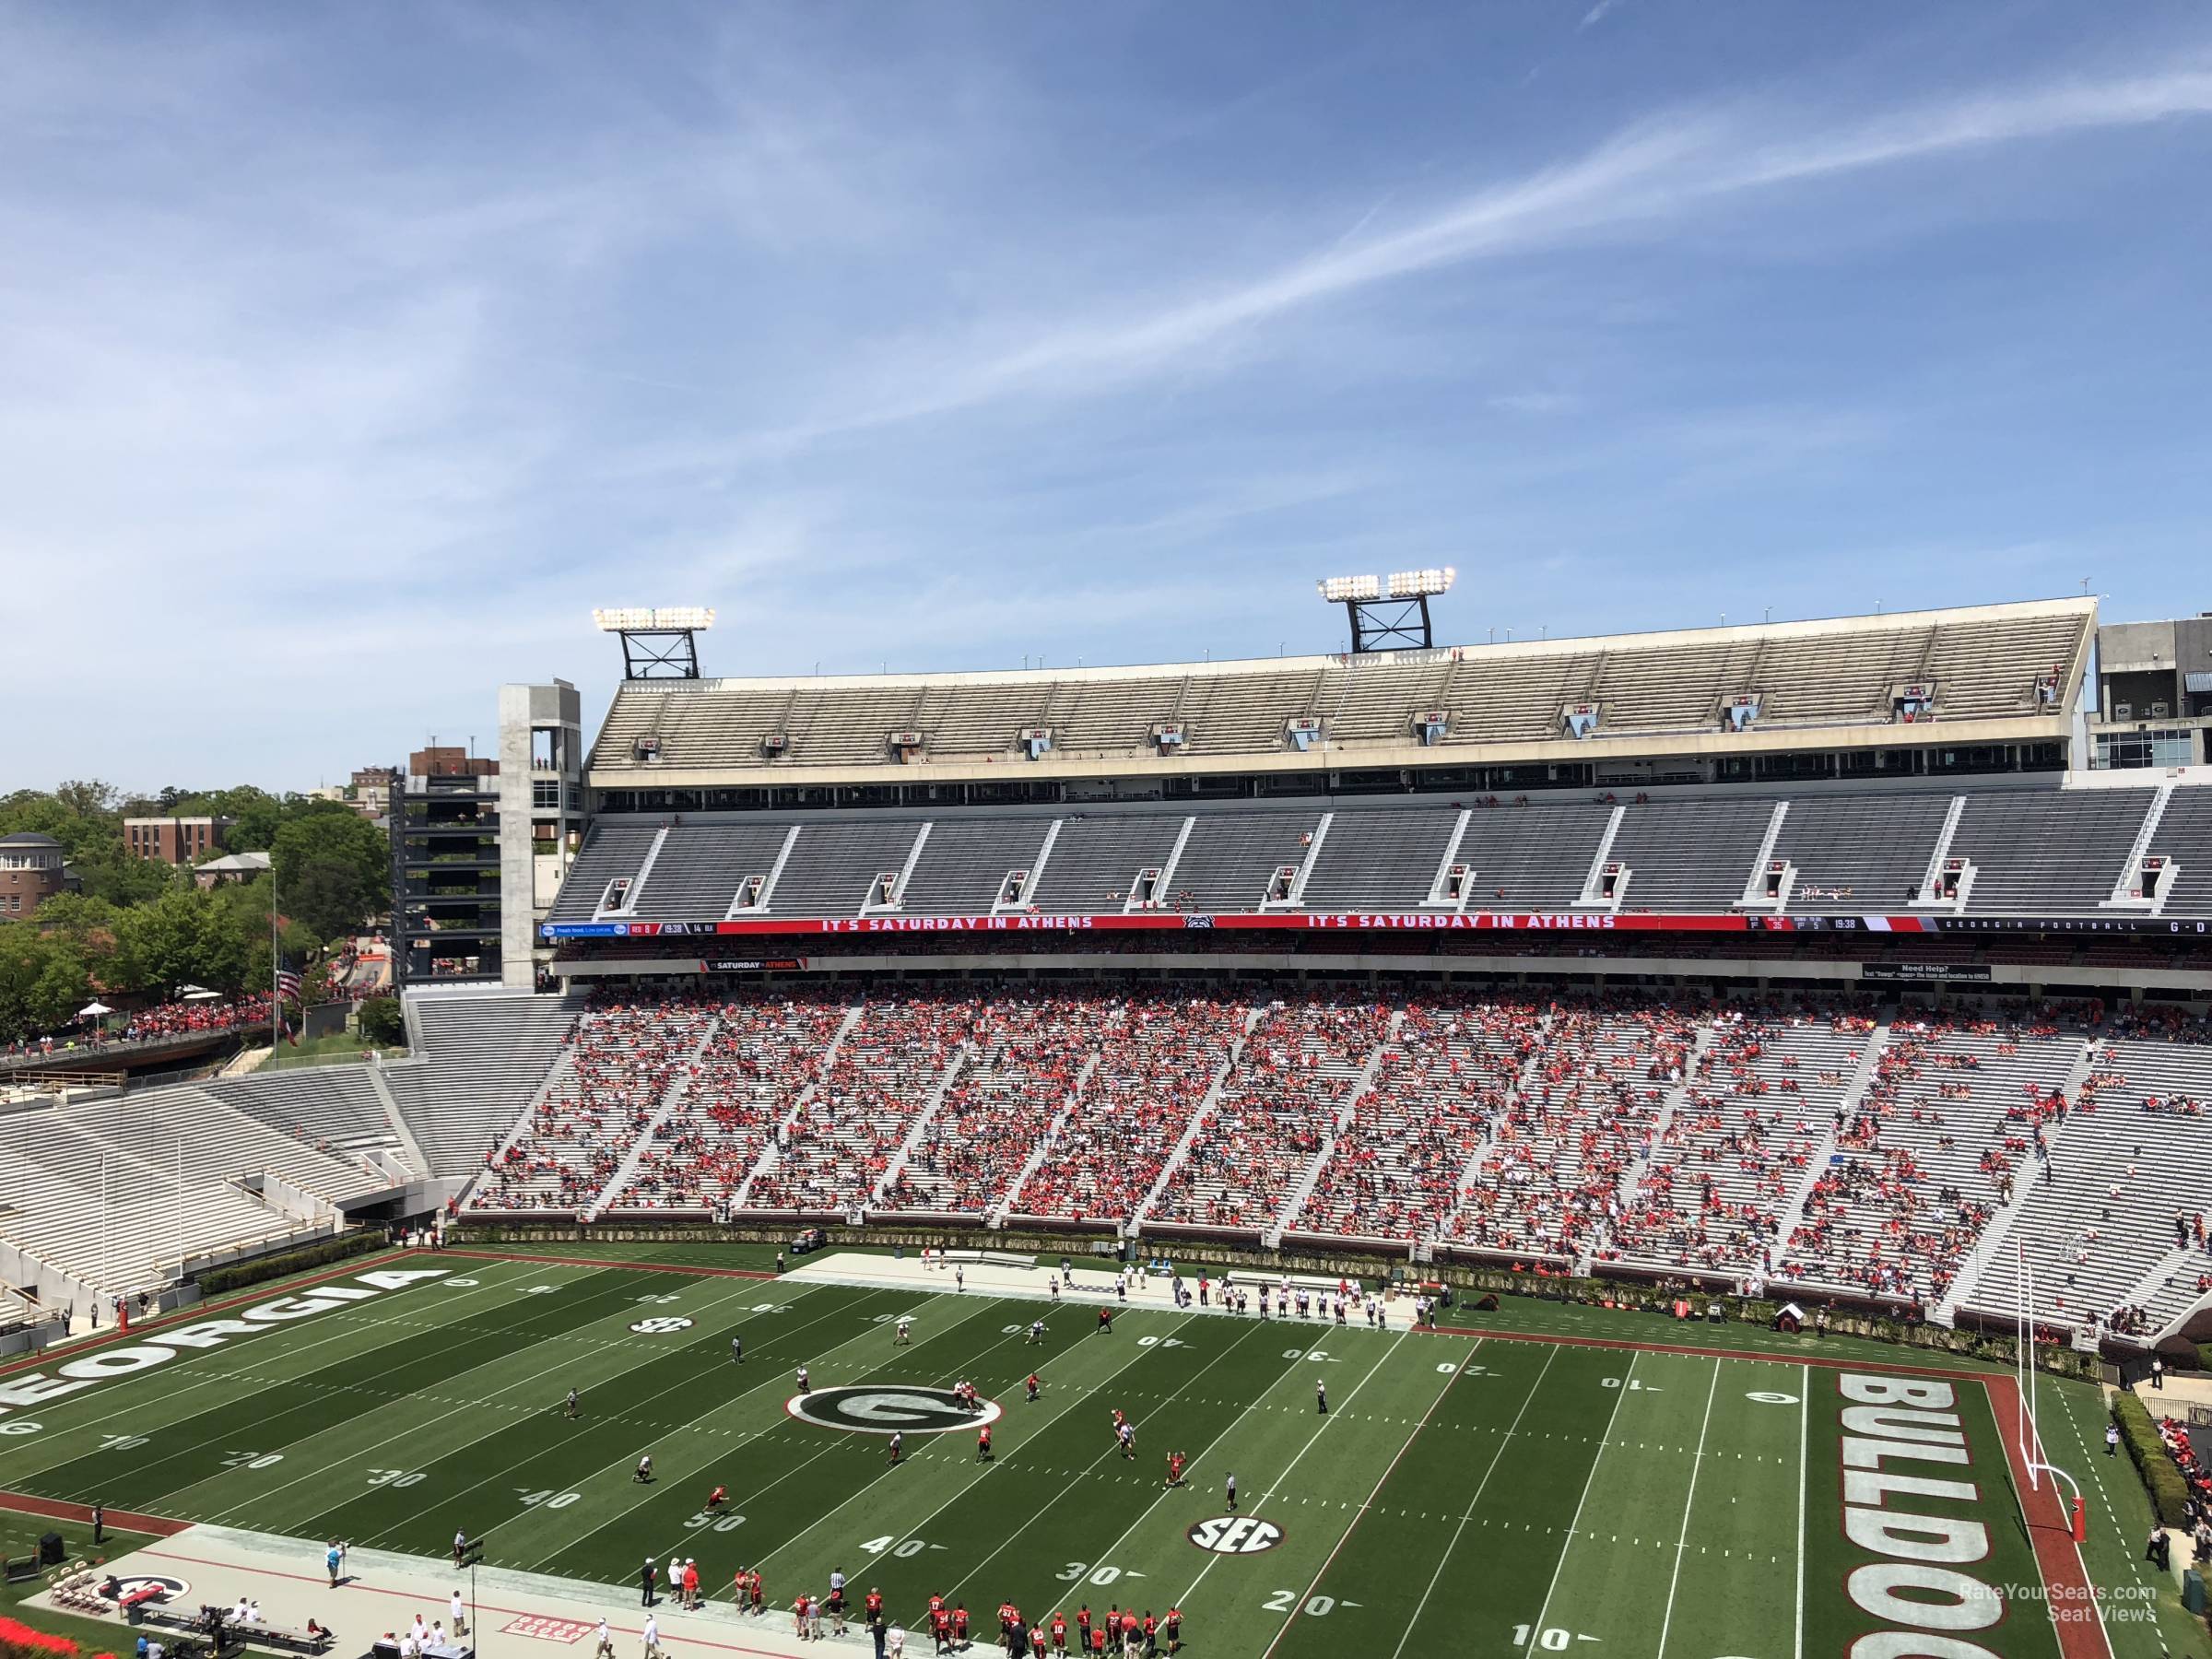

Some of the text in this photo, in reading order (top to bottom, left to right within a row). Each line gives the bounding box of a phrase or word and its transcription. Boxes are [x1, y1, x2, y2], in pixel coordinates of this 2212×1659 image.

[665, 924, 682, 933] 19:38
[822, 916, 1092, 931] IT'S SATURDAY IN ATHENS
[1309, 916, 1616, 928] IT'S SATURDAY IN ATHENS
[1836, 919, 1855, 928] 19:38
[2041, 922, 2136, 930] FOOTBALL
[0, 1270, 453, 1415] EORGIA
[1136, 1336, 1184, 1347] 40
[1282, 1349, 1329, 1361] 30
[1436, 1363, 1487, 1376] 20
[1601, 1378, 1641, 1390] 10
[219, 1452, 284, 1469] 20
[367, 1470, 428, 1488] 30
[518, 1489, 582, 1509] 40
[683, 1512, 747, 1532] 50
[1192, 1517, 1279, 1553] SEC
[858, 1535, 925, 1558] 40
[1055, 1562, 1122, 1585] 30
[932, 1602, 940, 1610] 17
[1262, 1590, 1335, 1616] 20
[1003, 1608, 1011, 1617] 57
[1054, 1625, 1064, 1634] 10
[1512, 1624, 1571, 1651] 10
